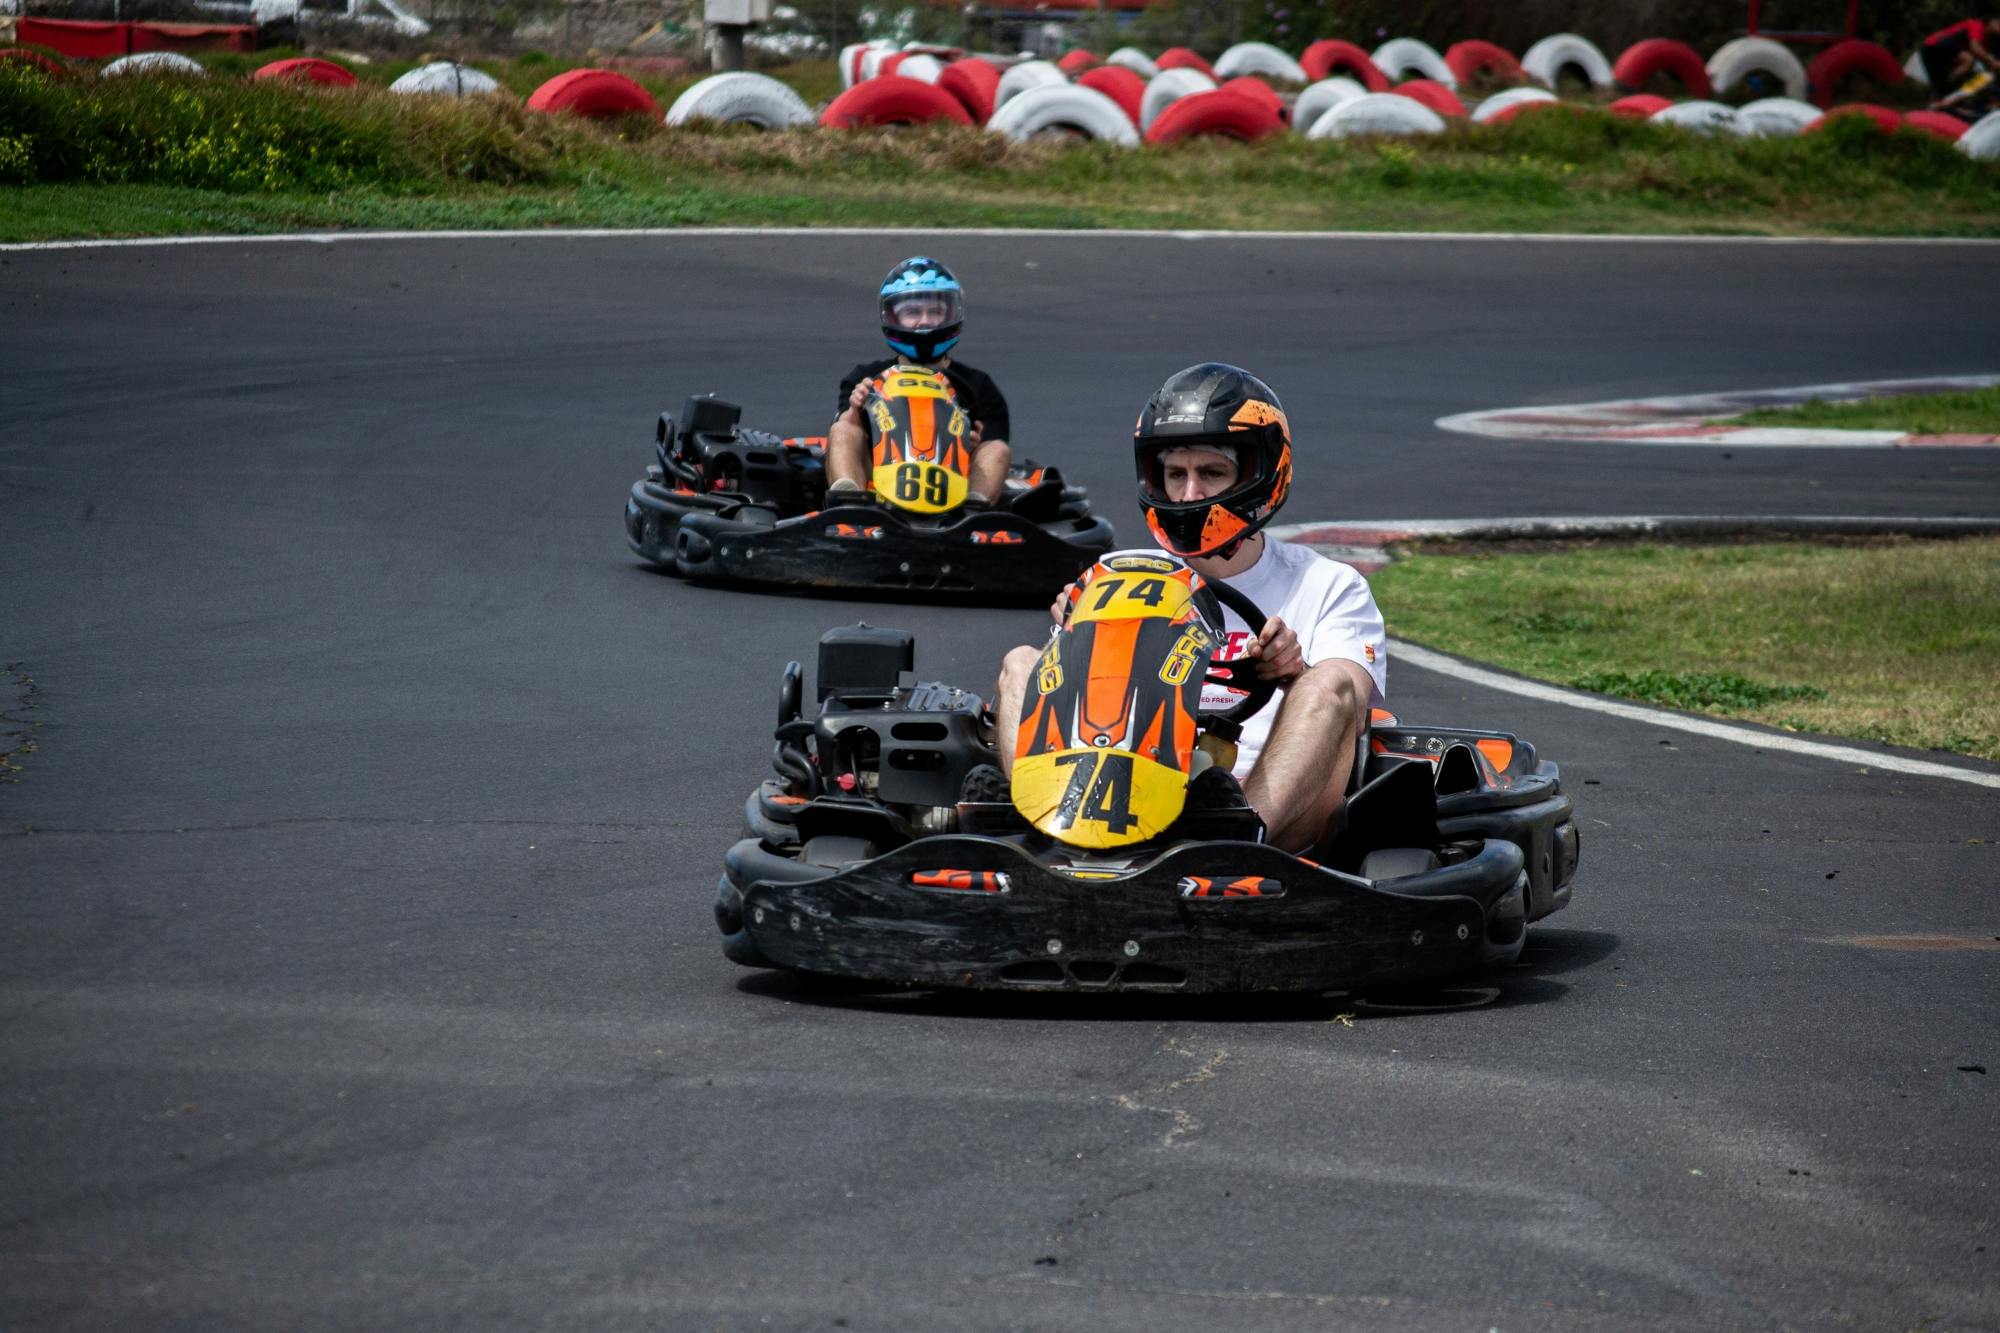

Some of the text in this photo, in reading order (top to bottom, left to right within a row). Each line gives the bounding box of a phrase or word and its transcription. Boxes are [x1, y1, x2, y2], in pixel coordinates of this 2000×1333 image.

[1154, 414, 1205, 426] LS2
[896, 463, 948, 506] 69
[1093, 579, 1166, 611] 74
[1055, 751, 1139, 835] 74
